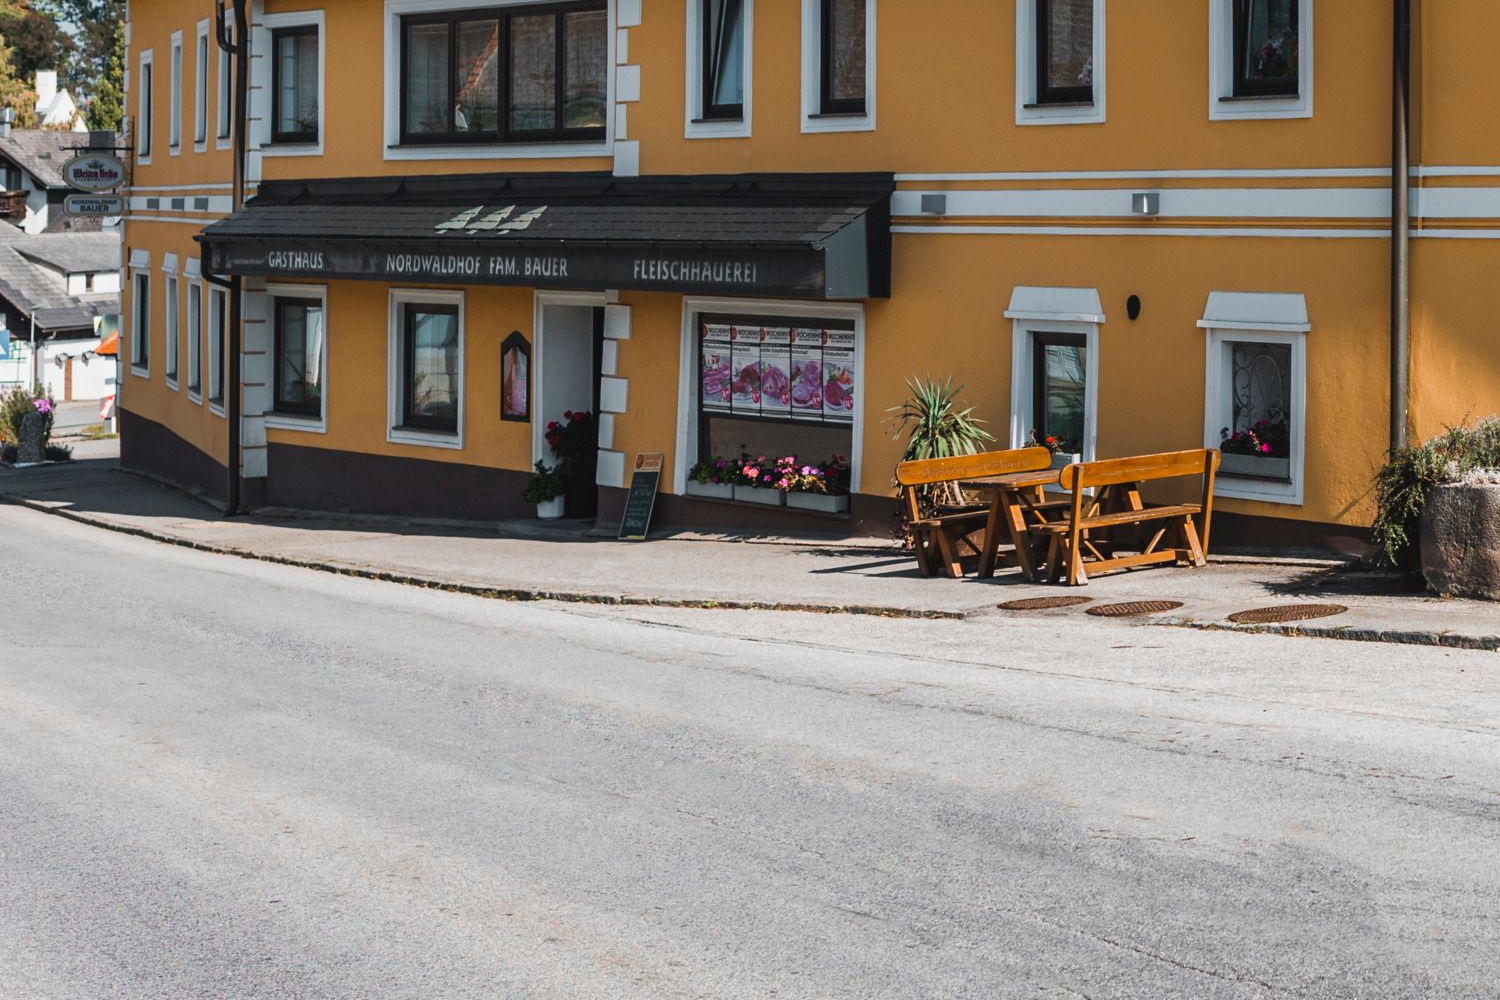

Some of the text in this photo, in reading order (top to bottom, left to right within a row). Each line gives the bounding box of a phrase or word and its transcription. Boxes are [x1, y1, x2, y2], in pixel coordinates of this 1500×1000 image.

[268, 251, 323, 269] GASTHAUS
[386, 253, 568, 277] NORDWALDHOF FAM. BAUER
[633, 259, 757, 283] FLEISCHHAUEREI
